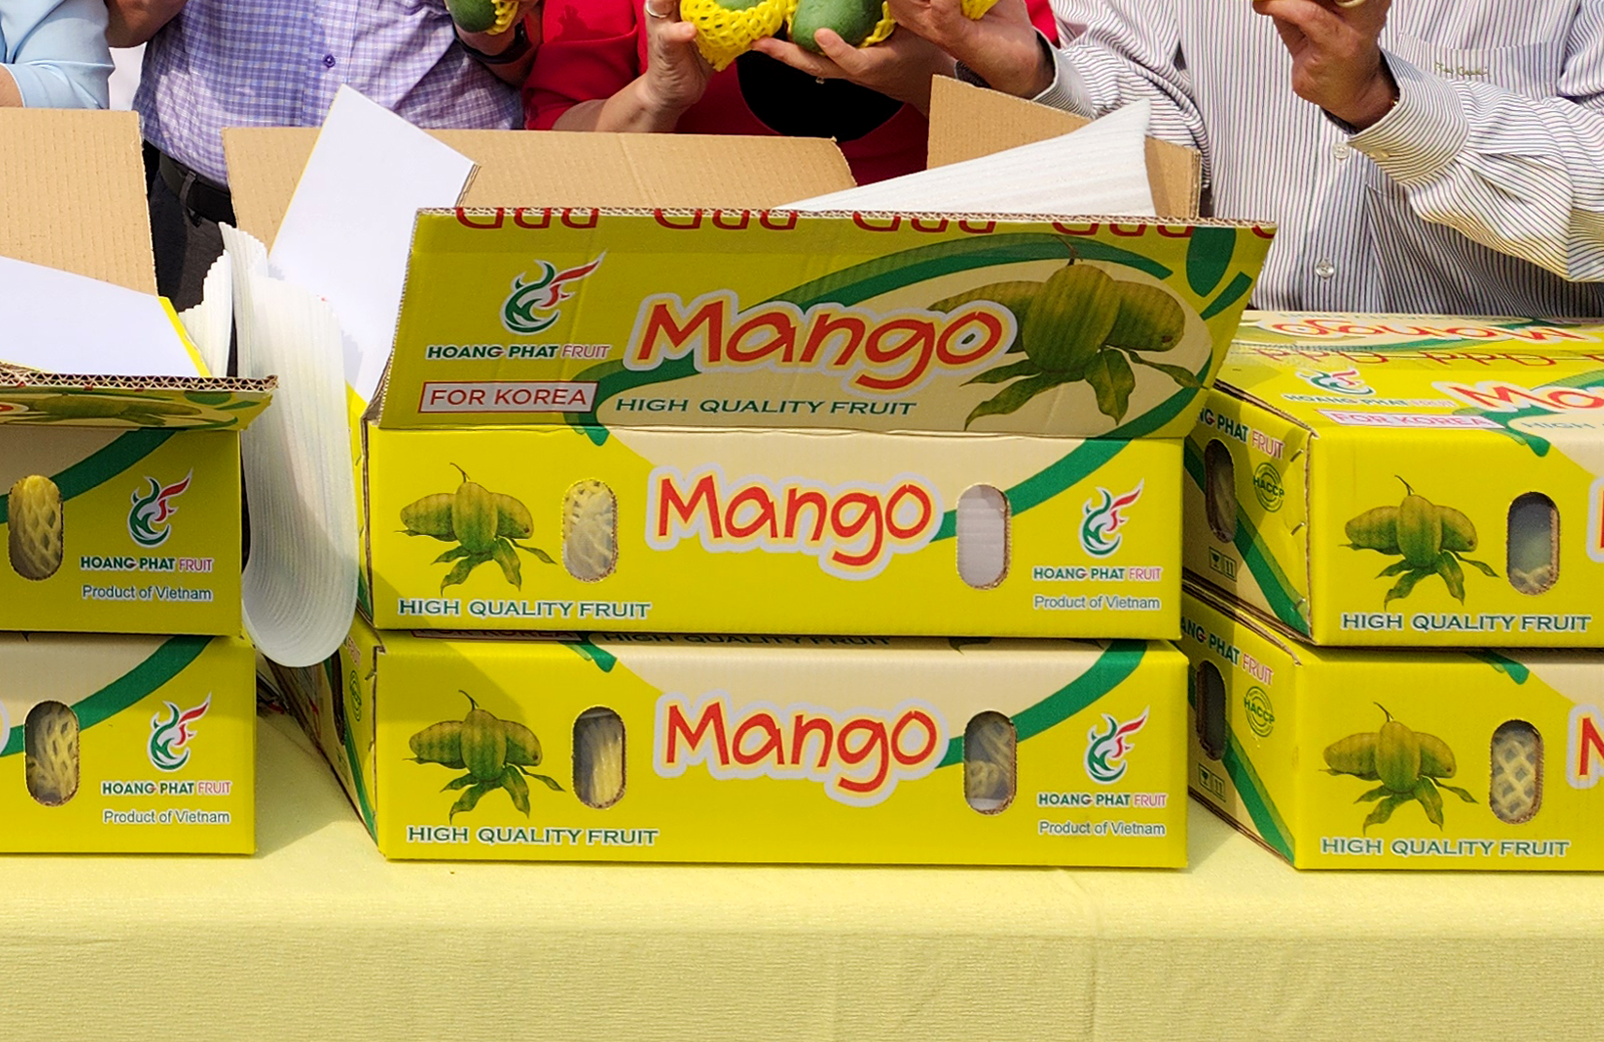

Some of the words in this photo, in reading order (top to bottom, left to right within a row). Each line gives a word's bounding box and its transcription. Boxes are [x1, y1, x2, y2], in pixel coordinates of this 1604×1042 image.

[427, 345, 504, 359] HOANG
[508, 345, 558, 359] PHAT
[561, 345, 610, 358] FRUIT
[636, 299, 1004, 391] Mango
[429, 389, 486, 406] FOR
[494, 389, 587, 406] KOREA
[615, 398, 689, 412] HIGH
[699, 399, 826, 415] QUALITY
[830, 401, 917, 415] FRUIT
[1330, 412, 1389, 424] FOR
[1397, 414, 1494, 427] KOREA
[1217, 414, 1249, 443] PHAT
[1251, 429, 1285, 459] FRUIT
[1252, 476, 1286, 499] HACCP
[658, 474, 932, 566] Mango
[81, 556, 136, 571] HOANG
[139, 557, 175, 571] PHAT
[178, 558, 213, 572] FRUIT
[1032, 567, 1087, 580] HOANG
[1090, 567, 1125, 580] PHAT
[1128, 567, 1161, 580] FRUIT
[82, 585, 135, 600] Product
[138, 586, 154, 600] of
[154, 586, 212, 601] Vietnam
[398, 599, 459, 615] HIGH
[469, 600, 574, 618] QUALITY
[578, 602, 650, 618] FRUIT
[1034, 595, 1087, 609] Product
[1090, 595, 1104, 609] of
[1105, 595, 1161, 609] Vietnam
[1342, 613, 1403, 629] HIGH
[1413, 614, 1516, 631] QUALITY
[1519, 615, 1591, 631] FRUIT
[603, 634, 675, 642] HIGH
[685, 635, 803, 644] QUALITY
[1181, 617, 1207, 643] ANG
[1209, 634, 1240, 665] PHAT
[1242, 654, 1274, 685] FRUIT
[1244, 696, 1275, 725] HACCP
[666, 701, 938, 793] Mango
[101, 782, 156, 795] HOANG
[159, 782, 195, 795] PHAT
[197, 782, 232, 795] FRUIT
[1037, 792, 1092, 806] HOANG
[1095, 793, 1131, 806] PHAT
[1133, 794, 1167, 807] FRUIT
[103, 809, 156, 824] Product
[158, 809, 173, 823] of
[175, 809, 231, 824] Vietnam
[407, 826, 469, 842] HIGH
[477, 827, 583, 845] QUALITY
[586, 829, 659, 845] FRUIT
[1039, 821, 1092, 835] Product
[1094, 821, 1109, 835] of
[1109, 821, 1166, 835] Vietnam
[1321, 838, 1382, 854] HIGH
[1391, 839, 1495, 856] QUALITY
[1499, 841, 1570, 856] FRUIT
